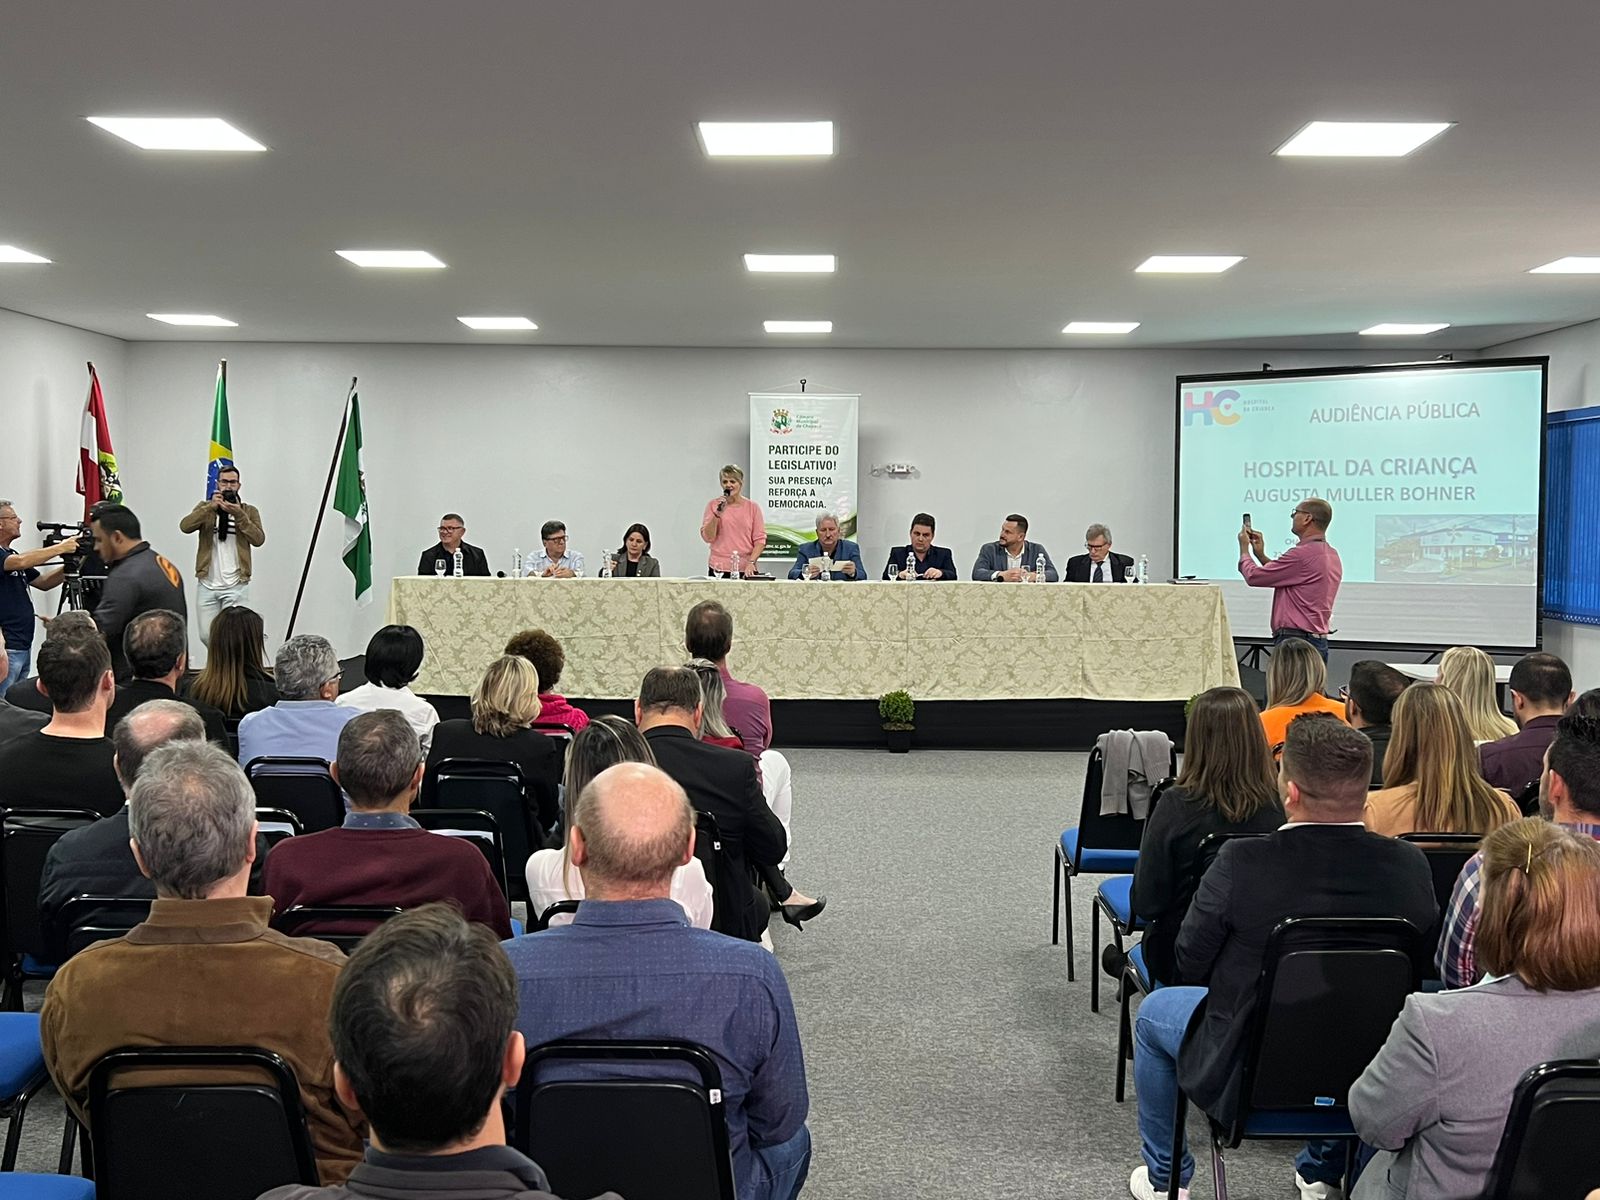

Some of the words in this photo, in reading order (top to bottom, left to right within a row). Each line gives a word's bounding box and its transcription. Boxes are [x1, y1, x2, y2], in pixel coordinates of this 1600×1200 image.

[1184, 389, 1241, 426] HC
[1309, 403, 1402, 424] AUDIÊNCIA
[1406, 400, 1481, 420] PÚBLICA
[768, 445, 822, 455] PARTICIPE
[825, 445, 839, 456] DO
[768, 460, 837, 471] LEGISLATIVO!
[1244, 460, 1339, 478] HOSPITAL
[1345, 459, 1374, 476] DA
[1380, 456, 1478, 479] CRIANÇA
[768, 476, 786, 485] SUA
[788, 476, 833, 487] PRESENÇA
[768, 488, 807, 498] REFORÇA
[809, 488, 816, 497] A
[1243, 487, 1320, 503] AUGUSTA
[1326, 487, 1394, 501] MULLER
[1400, 486, 1476, 501] BOHNER
[768, 500, 827, 509] DEMOCRACIA.
